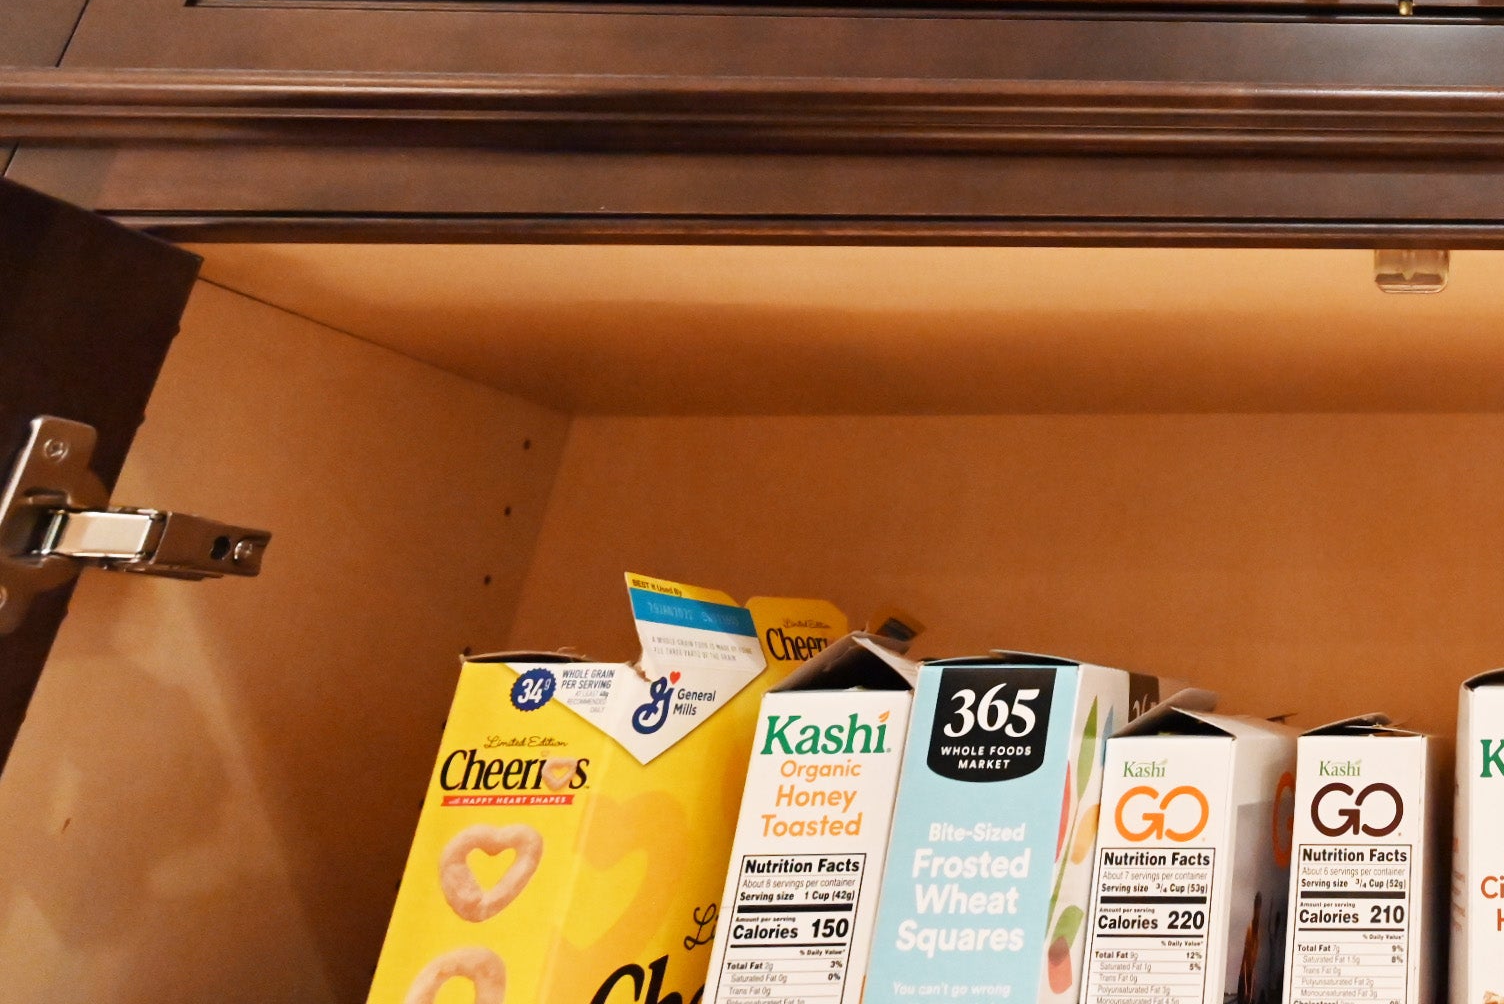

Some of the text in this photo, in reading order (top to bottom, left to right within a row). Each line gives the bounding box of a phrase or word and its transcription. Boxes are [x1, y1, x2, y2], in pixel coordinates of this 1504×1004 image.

[563, 669, 616, 679] WHOLE GRAIN
[561, 680, 612, 689] PER SERVING
[677, 688, 717, 702] General
[672, 703, 697, 716] Mills
[943, 682, 1040, 738] 365
[760, 711, 890, 755] Kashi
[484, 735, 568, 749] Limited Edition
[941, 746, 1032, 756] WHOLE FOODS
[780, 759, 862, 783] Organic
[958, 759, 1011, 769] MARKET
[1123, 758, 1168, 778] Kashi
[1318, 758, 1362, 777] Kashi
[462, 797, 494, 805] HAPPY
[496, 796, 527, 804] HEART
[530, 796, 568, 804] SHAPES
[775, 784, 857, 814] Honey
[1114, 785, 1210, 842] GO
[1310, 782, 1404, 838] GO
[761, 812, 863, 837] Toasted
[928, 822, 1027, 843] Bite-Sized
[1104, 851, 1210, 866] Nutrition Facts
[1302, 848, 1407, 862] Nutrition Facts
[745, 858, 860, 874] Nutrition Facts
[912, 848, 1032, 879] Frosted
[1103, 871, 1208, 882] About 7 servings per container
[1302, 867, 1405, 878] About 6 servings per container
[742, 879, 765, 889] About
[773, 879, 804, 890] servings
[805, 881, 818, 889] per
[820, 878, 855, 887] container
[1101, 883, 1131, 893] Serving
[1133, 883, 1149, 892] size
[1169, 883, 1185, 893] Cup
[1187, 883, 1208, 894] (53g)
[1301, 878, 1331, 889] Serving
[1332, 879, 1348, 888] size
[1369, 879, 1384, 889] Cup
[1386, 879, 1406, 889] (52g)
[740, 890, 855, 902] Serving size 1 Cup (42g)
[915, 883, 1020, 915] Wheat
[1098, 910, 1205, 930] Calories 220
[1299, 905, 1405, 924] Calories 210
[733, 918, 849, 940] Calories 150
[895, 919, 1025, 958] Squares
[1095, 951, 1114, 959] Total
[1116, 951, 1129, 959] Fat
[1186, 951, 1203, 959] 12%
[1297, 944, 1317, 952] Total
[1318, 944, 1331, 952] Fat
[726, 962, 747, 970] Total
[749, 962, 763, 970] Fat
[830, 960, 843, 968] 3%
[1100, 962, 1130, 971] Saturated
[1131, 963, 1142, 971] Fat
[1189, 963, 1201, 971] 5%
[1302, 956, 1333, 964] Saturated
[1334, 956, 1345, 964] Fat
[731, 974, 764, 983] Saturated
[765, 974, 777, 982] Fat
[828, 973, 841, 981] 0%
[893, 981, 1011, 998] You can't go wrong
